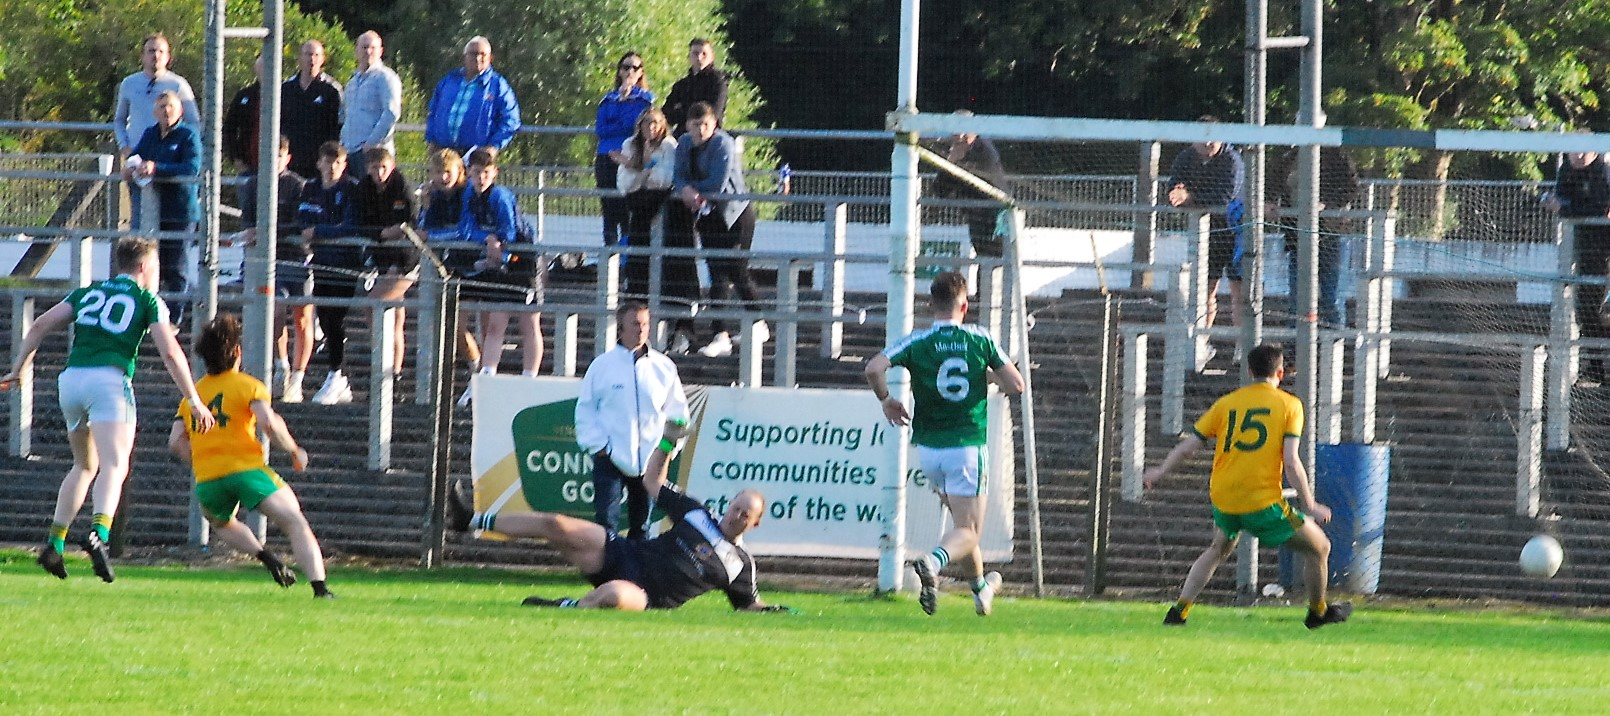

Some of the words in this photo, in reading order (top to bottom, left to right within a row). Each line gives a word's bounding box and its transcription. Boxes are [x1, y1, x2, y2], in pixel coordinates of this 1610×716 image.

[77, 289, 136, 335] 20
[937, 357, 970, 402] 6
[715, 418, 863, 450] Supporting
[1223, 408, 1271, 453] 15
[527, 449, 595, 476] CONN
[710, 458, 877, 486] communities
[770, 496, 797, 520] of
[806, 498, 847, 522] the
